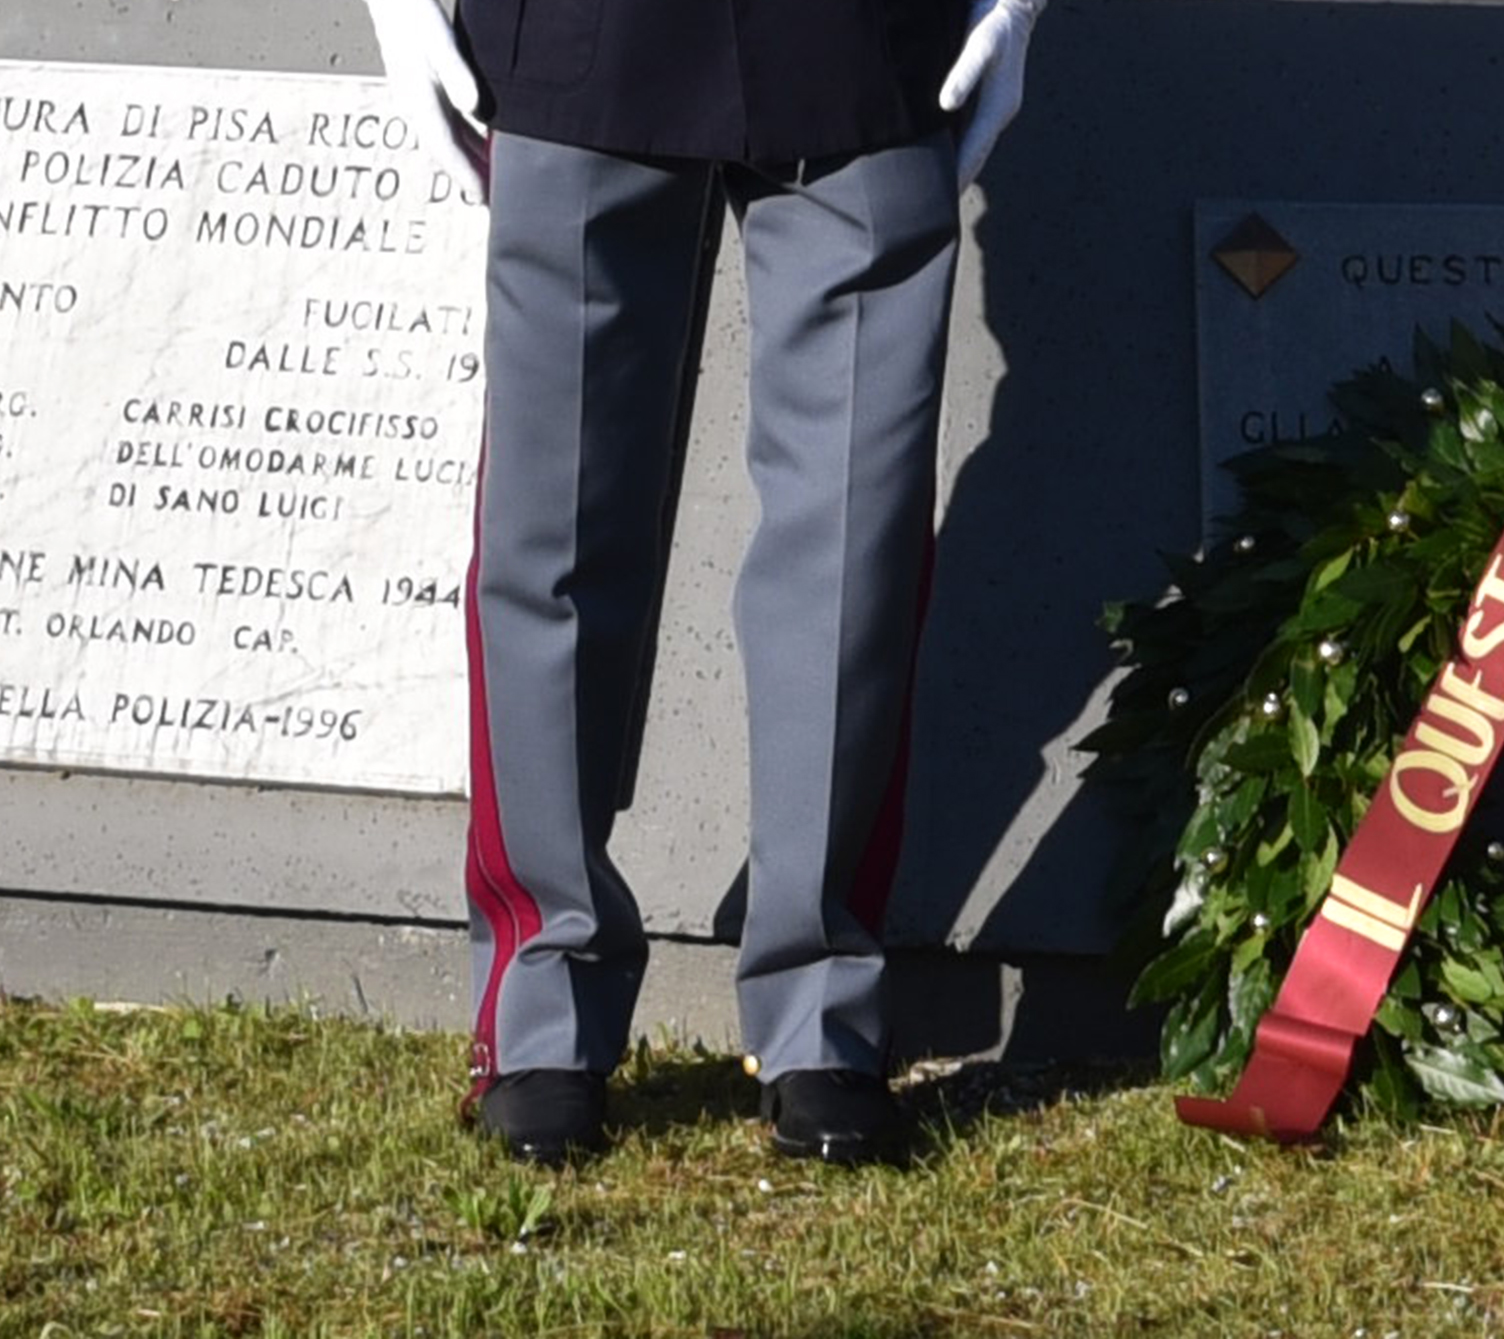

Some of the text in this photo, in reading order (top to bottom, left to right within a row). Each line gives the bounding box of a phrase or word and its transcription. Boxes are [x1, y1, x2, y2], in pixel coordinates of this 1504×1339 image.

[120, 104, 161, 138] DI
[187, 106, 279, 145] PISA
[307, 112, 421, 151] RICO
[20, 149, 186, 190] POLIZIA
[216, 160, 402, 202] CADUTO
[195, 209, 429, 256] MONDIALE
[303, 297, 475, 336] FUCILATI
[224, 340, 342, 377] DALLE
[445, 352, 480, 384] 19
[121, 397, 440, 441] CARRISI CROCIFISSO
[115, 439, 376, 482] DELL'OMODARME
[107, 481, 345, 522] DI SANO LUIGI
[66, 554, 166, 592] MINA
[194, 562, 355, 604] TEDESCA
[381, 576, 463, 609] 1944
[45, 611, 197, 647] ORLANDO
[233, 625, 300, 655] CAP.
[1320, 873, 1423, 952] IL
